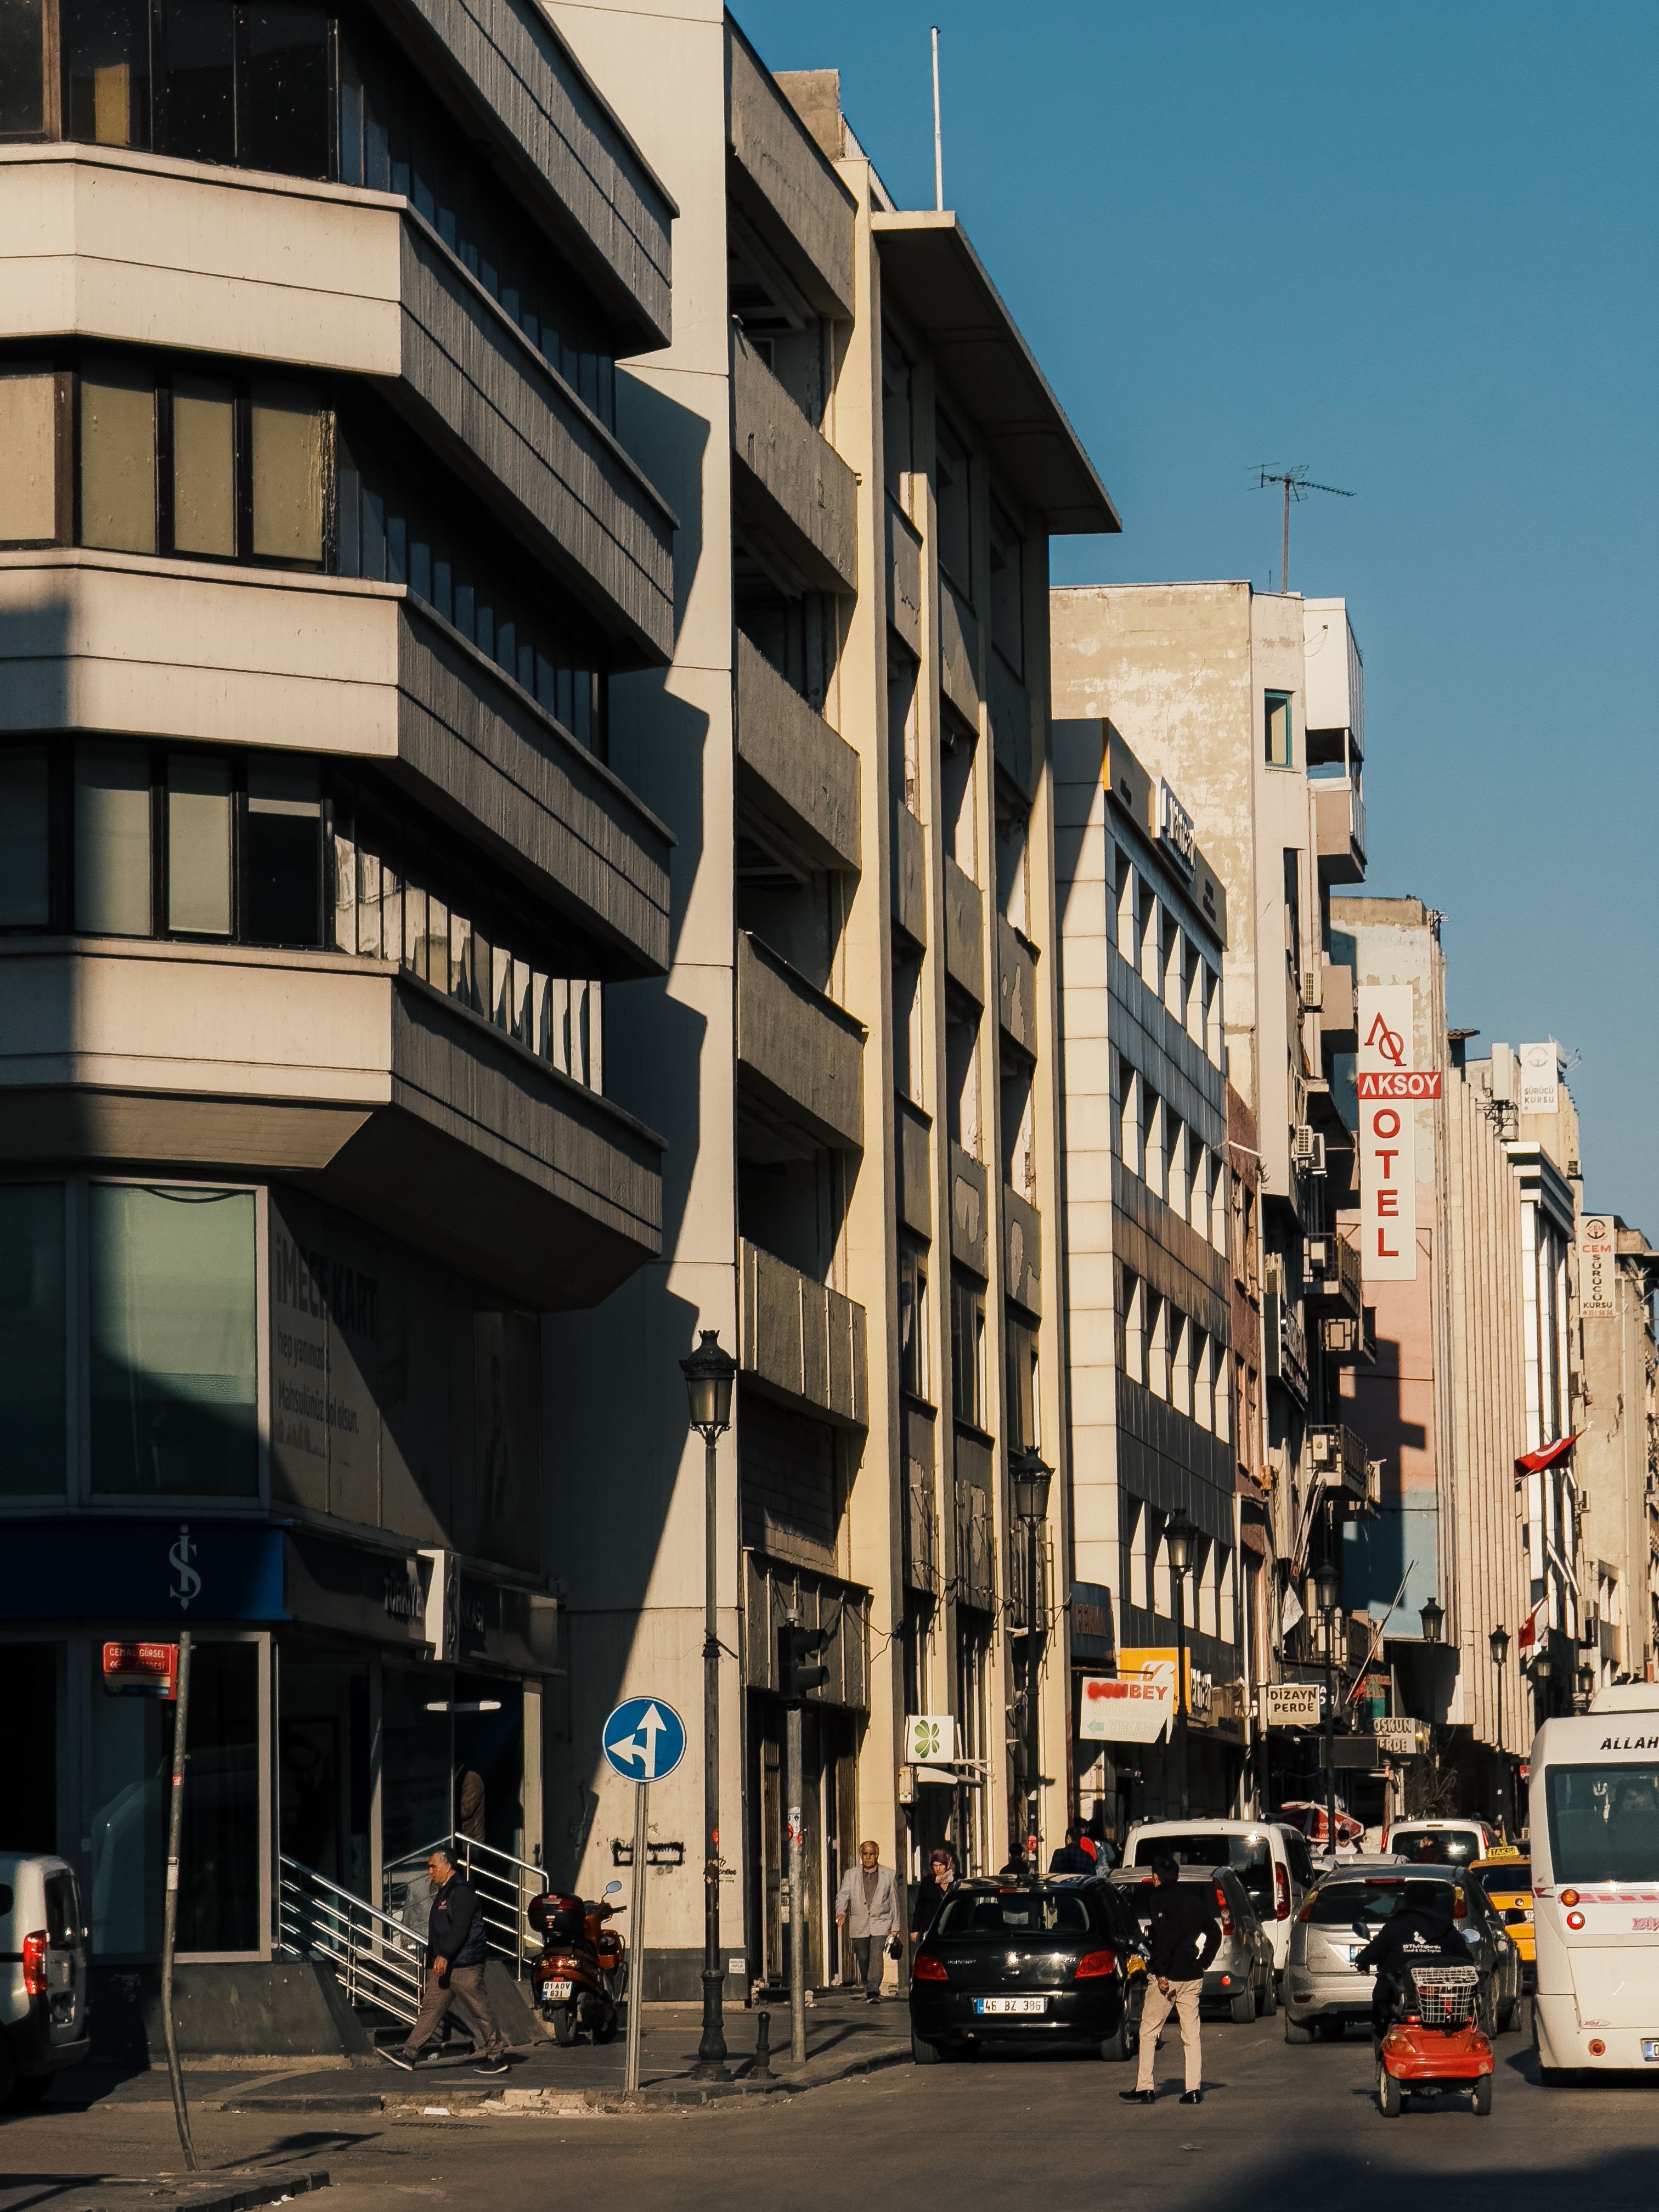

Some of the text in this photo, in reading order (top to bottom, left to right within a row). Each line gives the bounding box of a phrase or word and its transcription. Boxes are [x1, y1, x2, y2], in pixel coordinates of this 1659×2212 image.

[1361, 1074, 1439, 1096] AKSOY
[1373, 1109, 1400, 1257] OTEL
[1582, 1245, 1612, 1253] CEM
[1592, 1254, 1602, 1301] SÜRÜCÜ
[109, 1647, 165, 1658] CEMAL GÜRSEL
[1271, 1687, 1318, 1702] DİZAYN
[1274, 1702, 1314, 1712] PERDE
[1380, 1738, 1407, 1753] ERDE
[1600, 1736, 1659, 1750] ALLAH
[985, 2000, 997, 2011] 46
[1005, 2000, 1017, 2011] BZ
